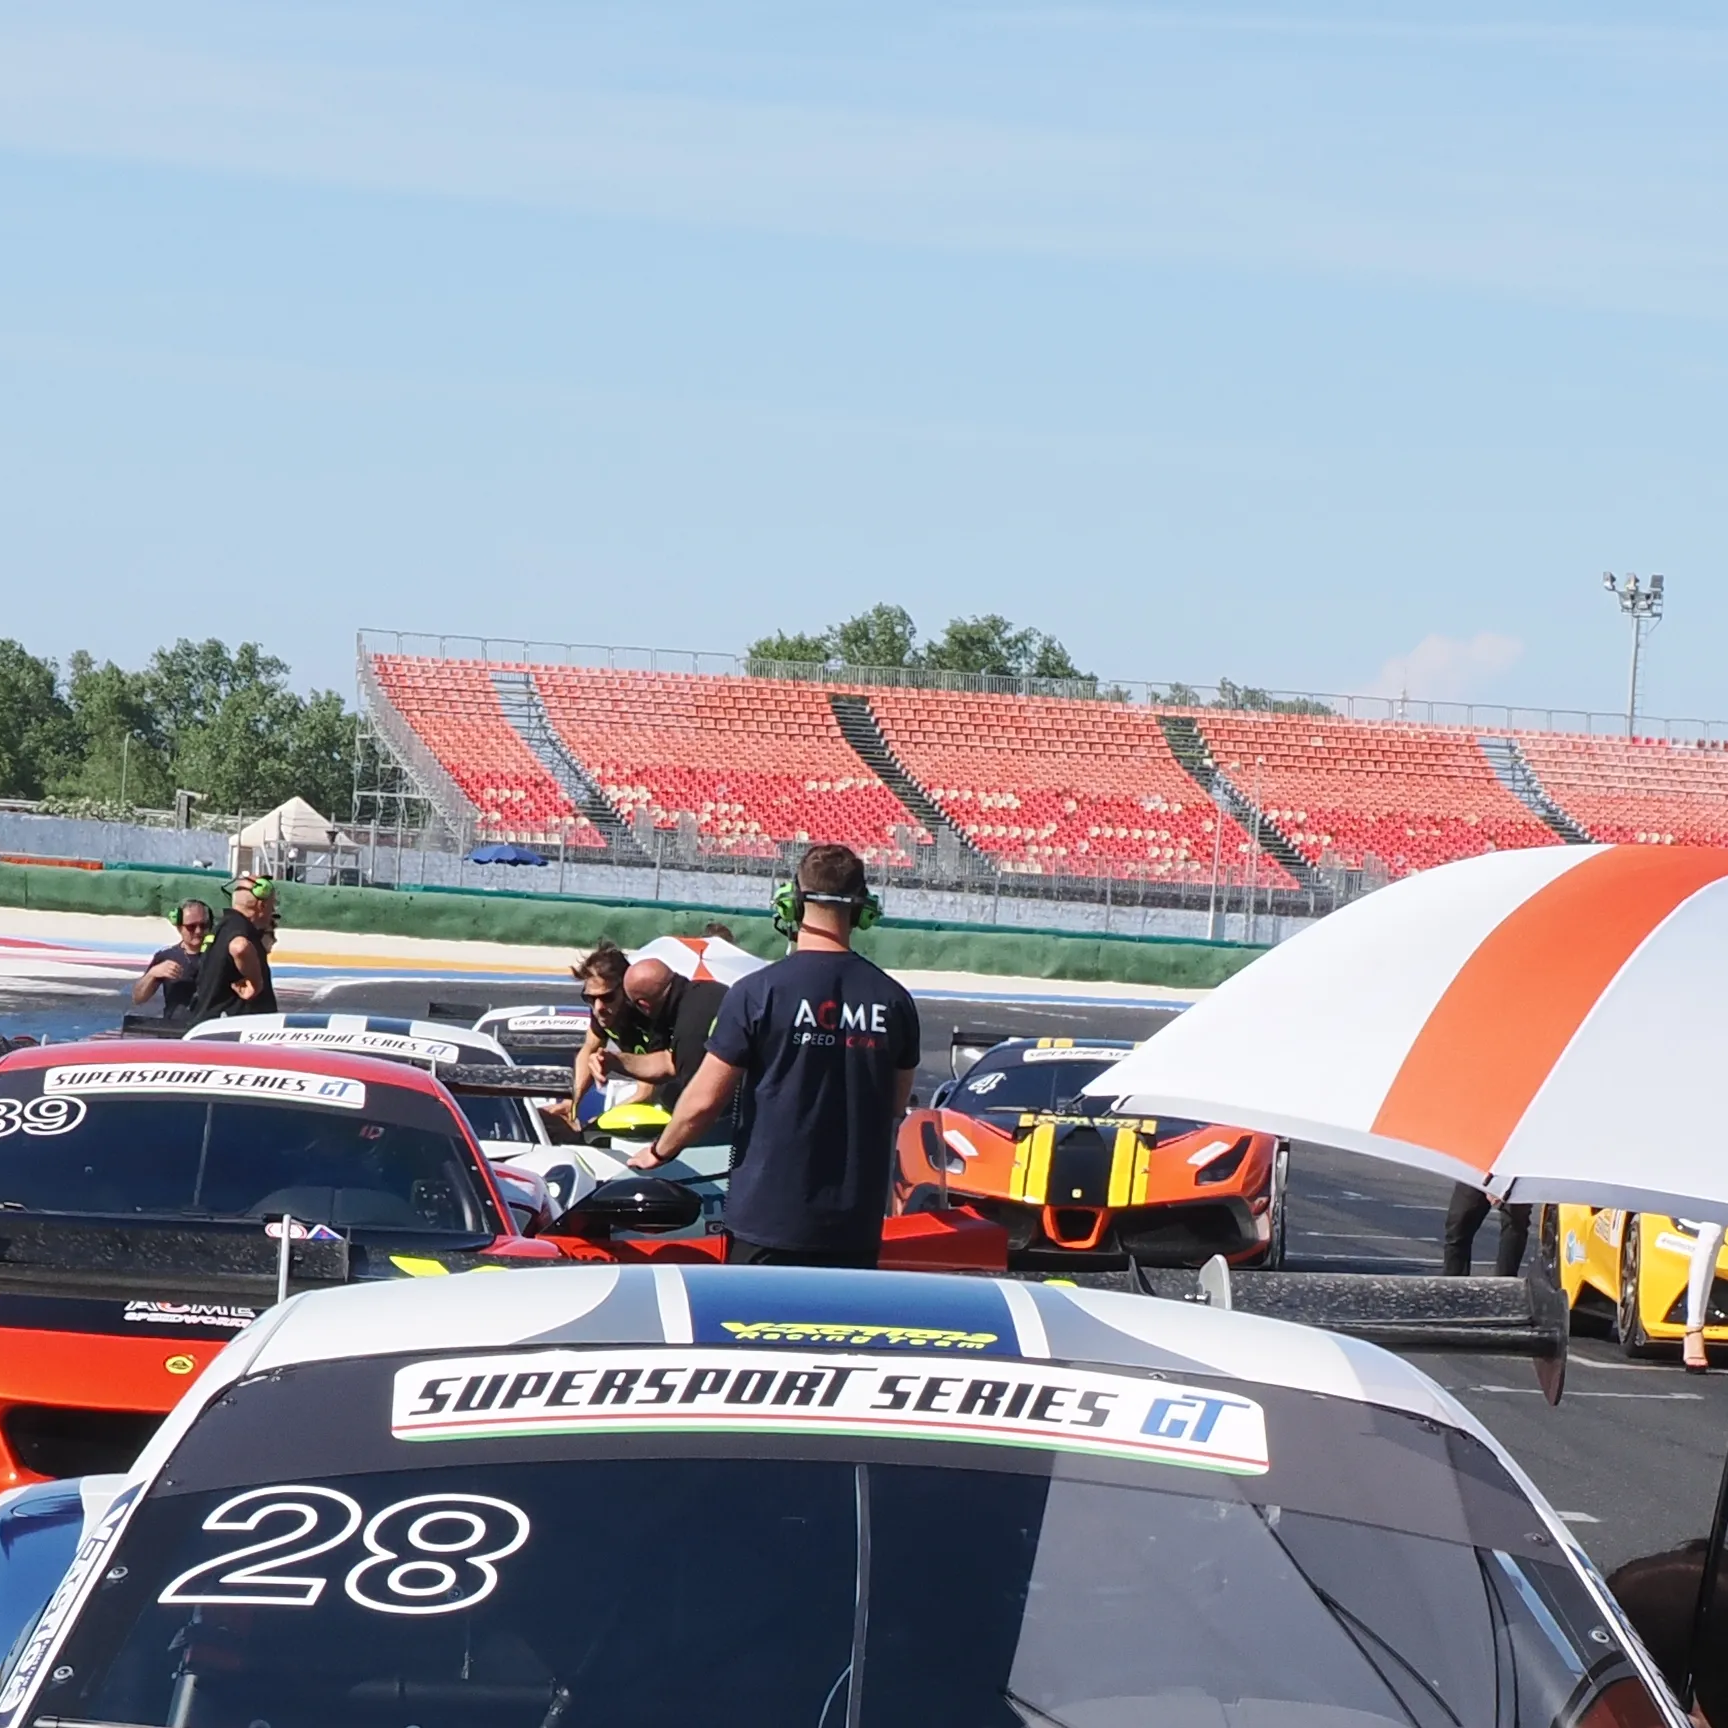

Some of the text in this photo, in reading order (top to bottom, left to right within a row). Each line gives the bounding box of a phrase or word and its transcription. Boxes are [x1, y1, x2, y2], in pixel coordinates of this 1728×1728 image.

[793, 997, 888, 1034] ACME
[247, 1031, 451, 1057] SUPERSPORT SERIES GT
[52, 1068, 360, 1098] SUPERSPORT SERIES GT
[734, 1331, 989, 1350] Racing Team
[408, 1363, 1253, 1444] SUPERSPORT SERIES GT
[157, 1483, 530, 1616] 28
